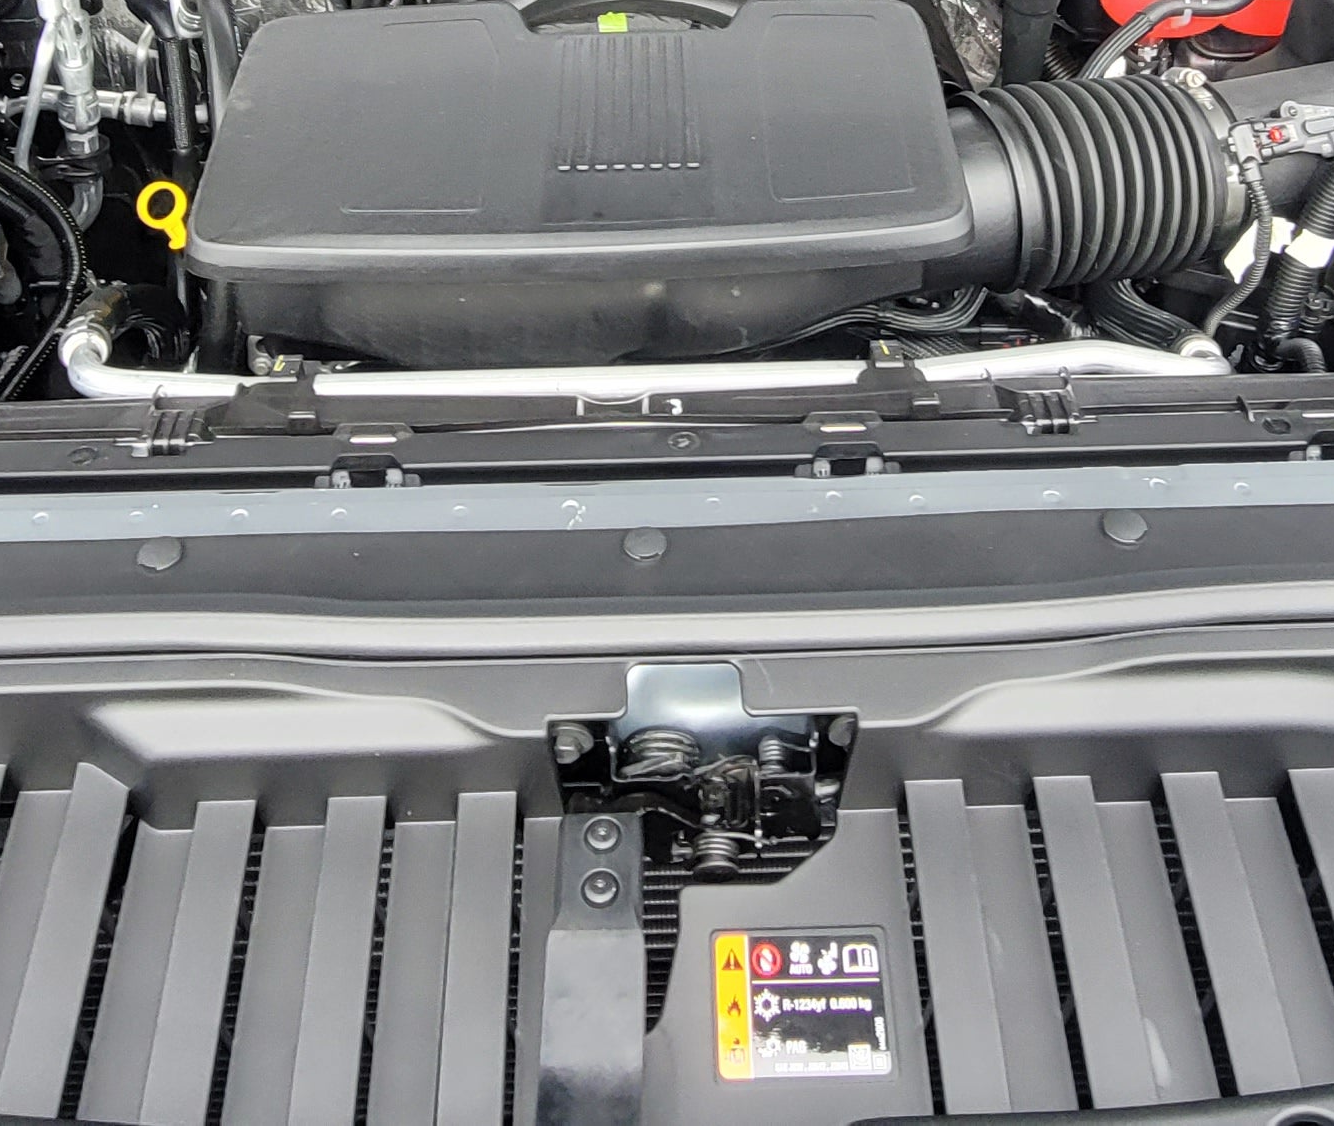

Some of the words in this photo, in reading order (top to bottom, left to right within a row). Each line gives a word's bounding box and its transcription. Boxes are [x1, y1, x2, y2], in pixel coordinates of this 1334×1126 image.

[789, 963, 813, 975] AUTO
[782, 997, 827, 1013] R-1234yf
[858, 996, 873, 1012] kg
